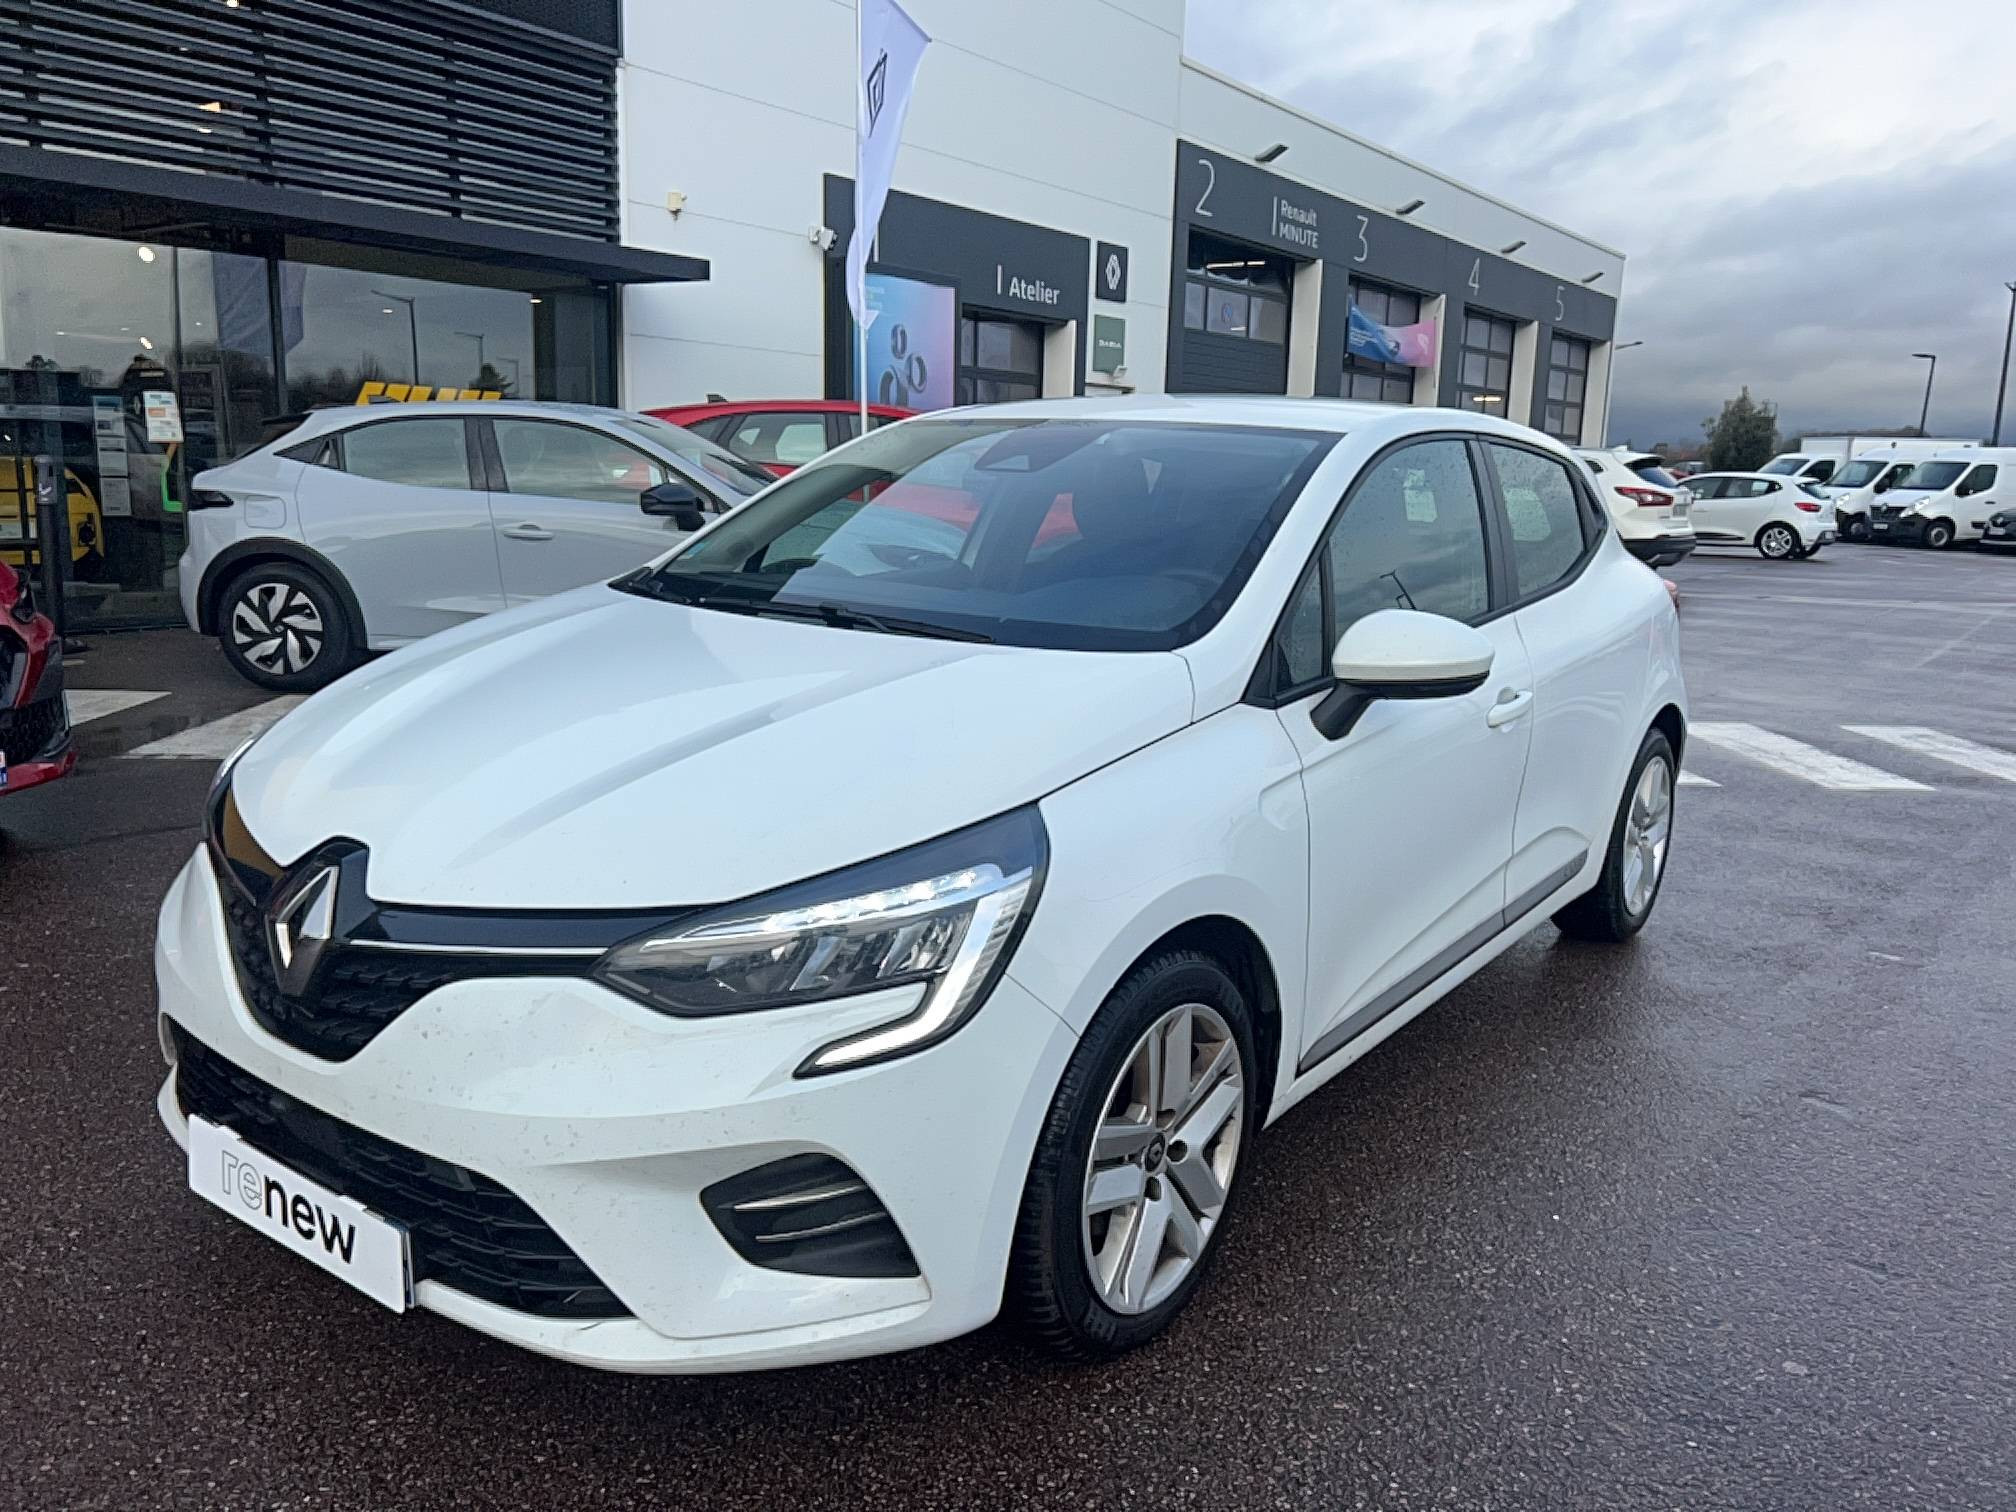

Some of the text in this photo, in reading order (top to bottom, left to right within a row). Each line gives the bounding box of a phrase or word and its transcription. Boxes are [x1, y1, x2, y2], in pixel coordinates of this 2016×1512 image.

[1195, 159, 1215, 217] 2
[1281, 200, 1317, 227] Renault
[1280, 222, 1319, 249] MINUTE
[1353, 215, 1369, 262] 3
[1009, 277, 1060, 305] Atelier
[1468, 258, 1480, 296] 4
[1555, 285, 1565, 321] 5
[221, 1150, 356, 1264] renew
